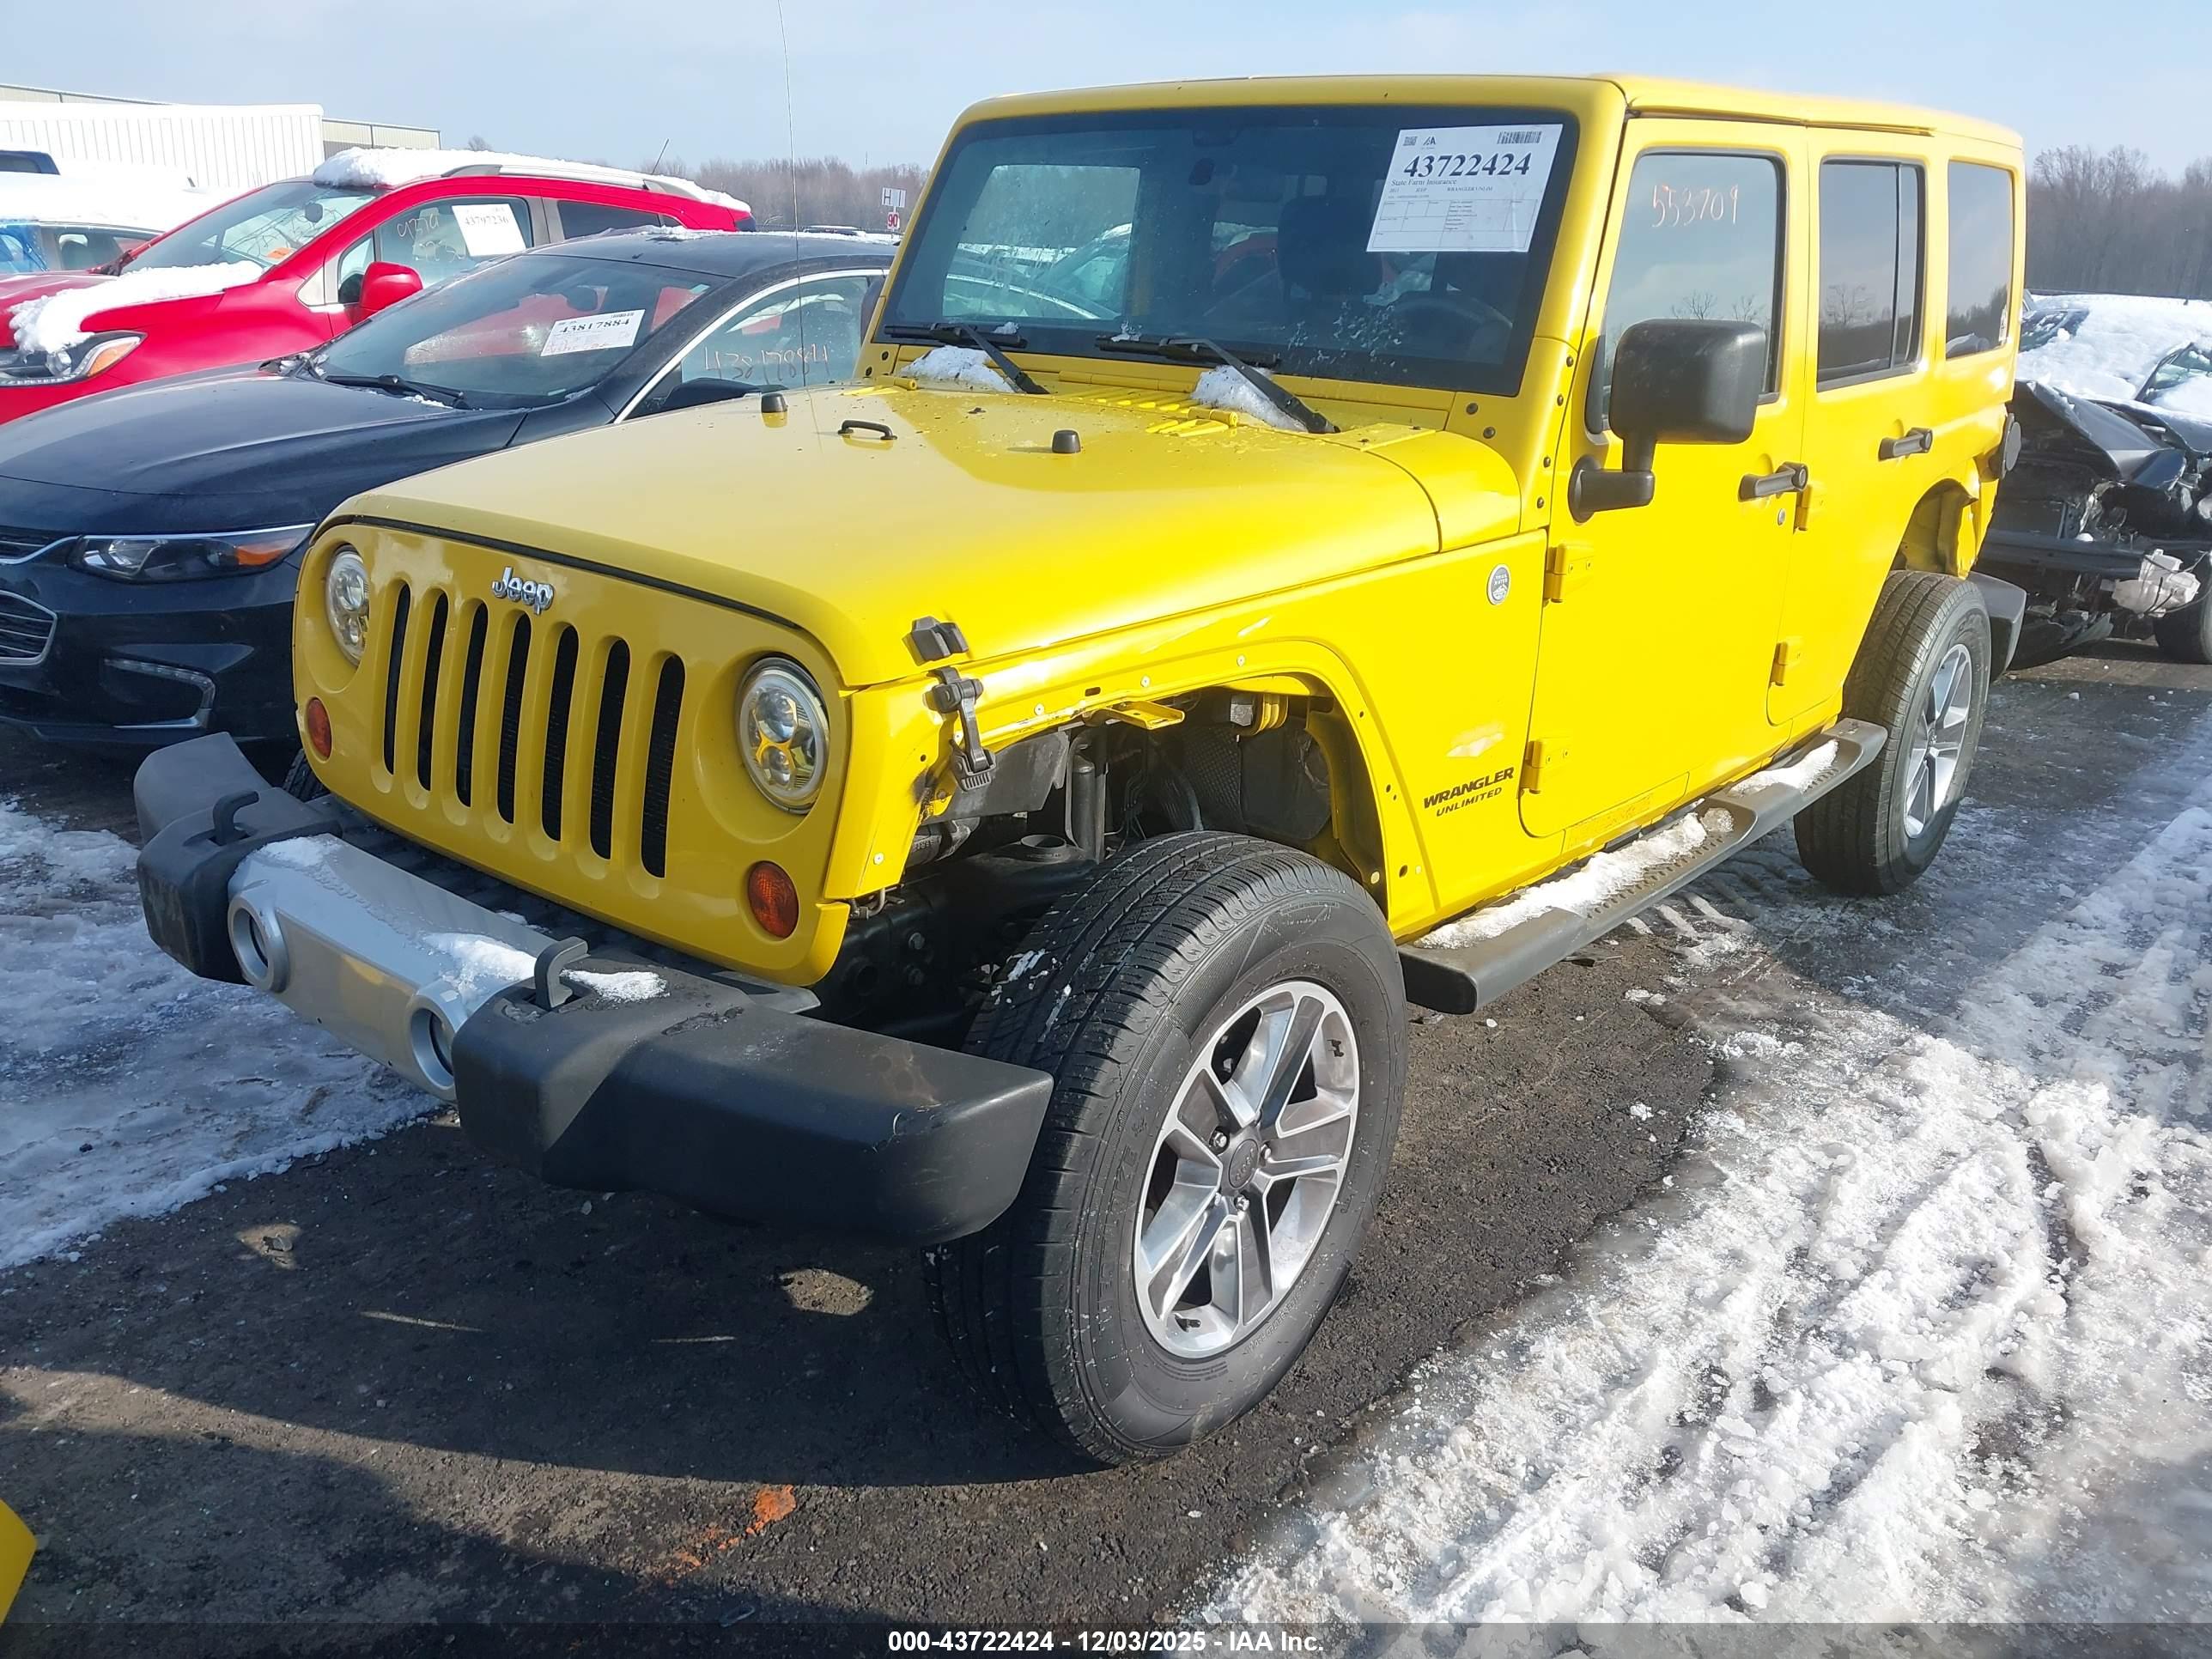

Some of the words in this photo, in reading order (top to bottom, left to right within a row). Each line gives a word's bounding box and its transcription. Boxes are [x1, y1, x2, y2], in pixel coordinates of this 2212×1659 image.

[1403, 152, 1532, 178] 43722424
[888, 214, 898, 228] 90
[560, 319, 630, 333] 43817884
[491, 566, 555, 616] Jeep
[1424, 766, 1514, 809] WRANGLER
[1436, 787, 1502, 817] UNLIMITED
